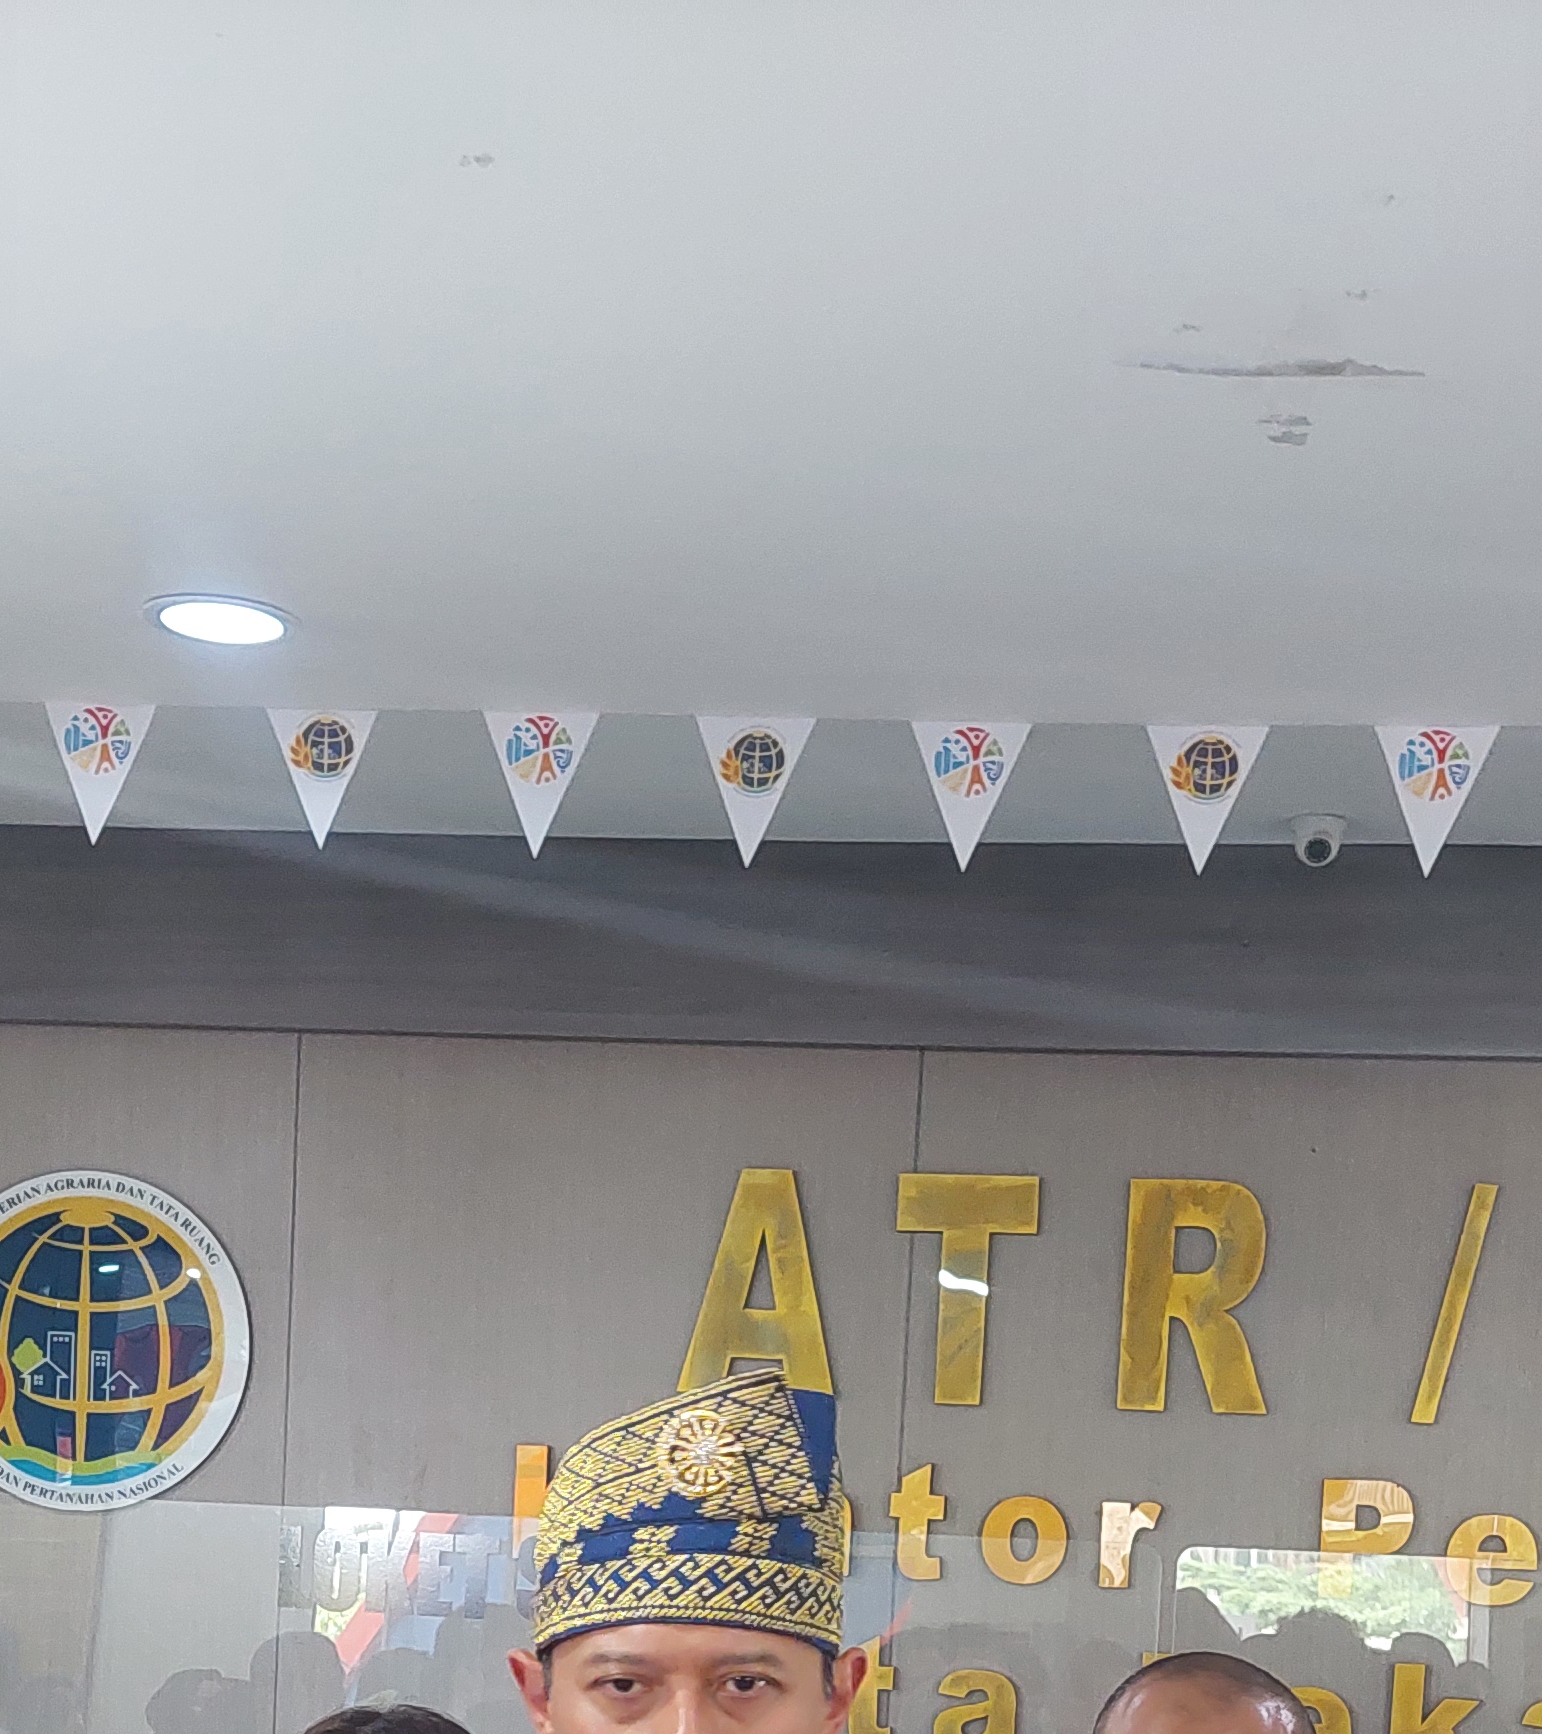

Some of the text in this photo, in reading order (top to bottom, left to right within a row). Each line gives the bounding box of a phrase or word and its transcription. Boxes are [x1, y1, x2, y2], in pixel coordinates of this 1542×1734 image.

[44, 1178, 112, 1195] AGRARIA
[114, 1181, 147, 1201] DAN
[148, 1193, 180, 1223] TATA
[180, 1217, 221, 1266] RUANG
[675, 1167, 1267, 1415] ATR
[22, 1480, 115, 1506] PERTANAHAN
[117, 1461, 185, 1500] NASIONAL
